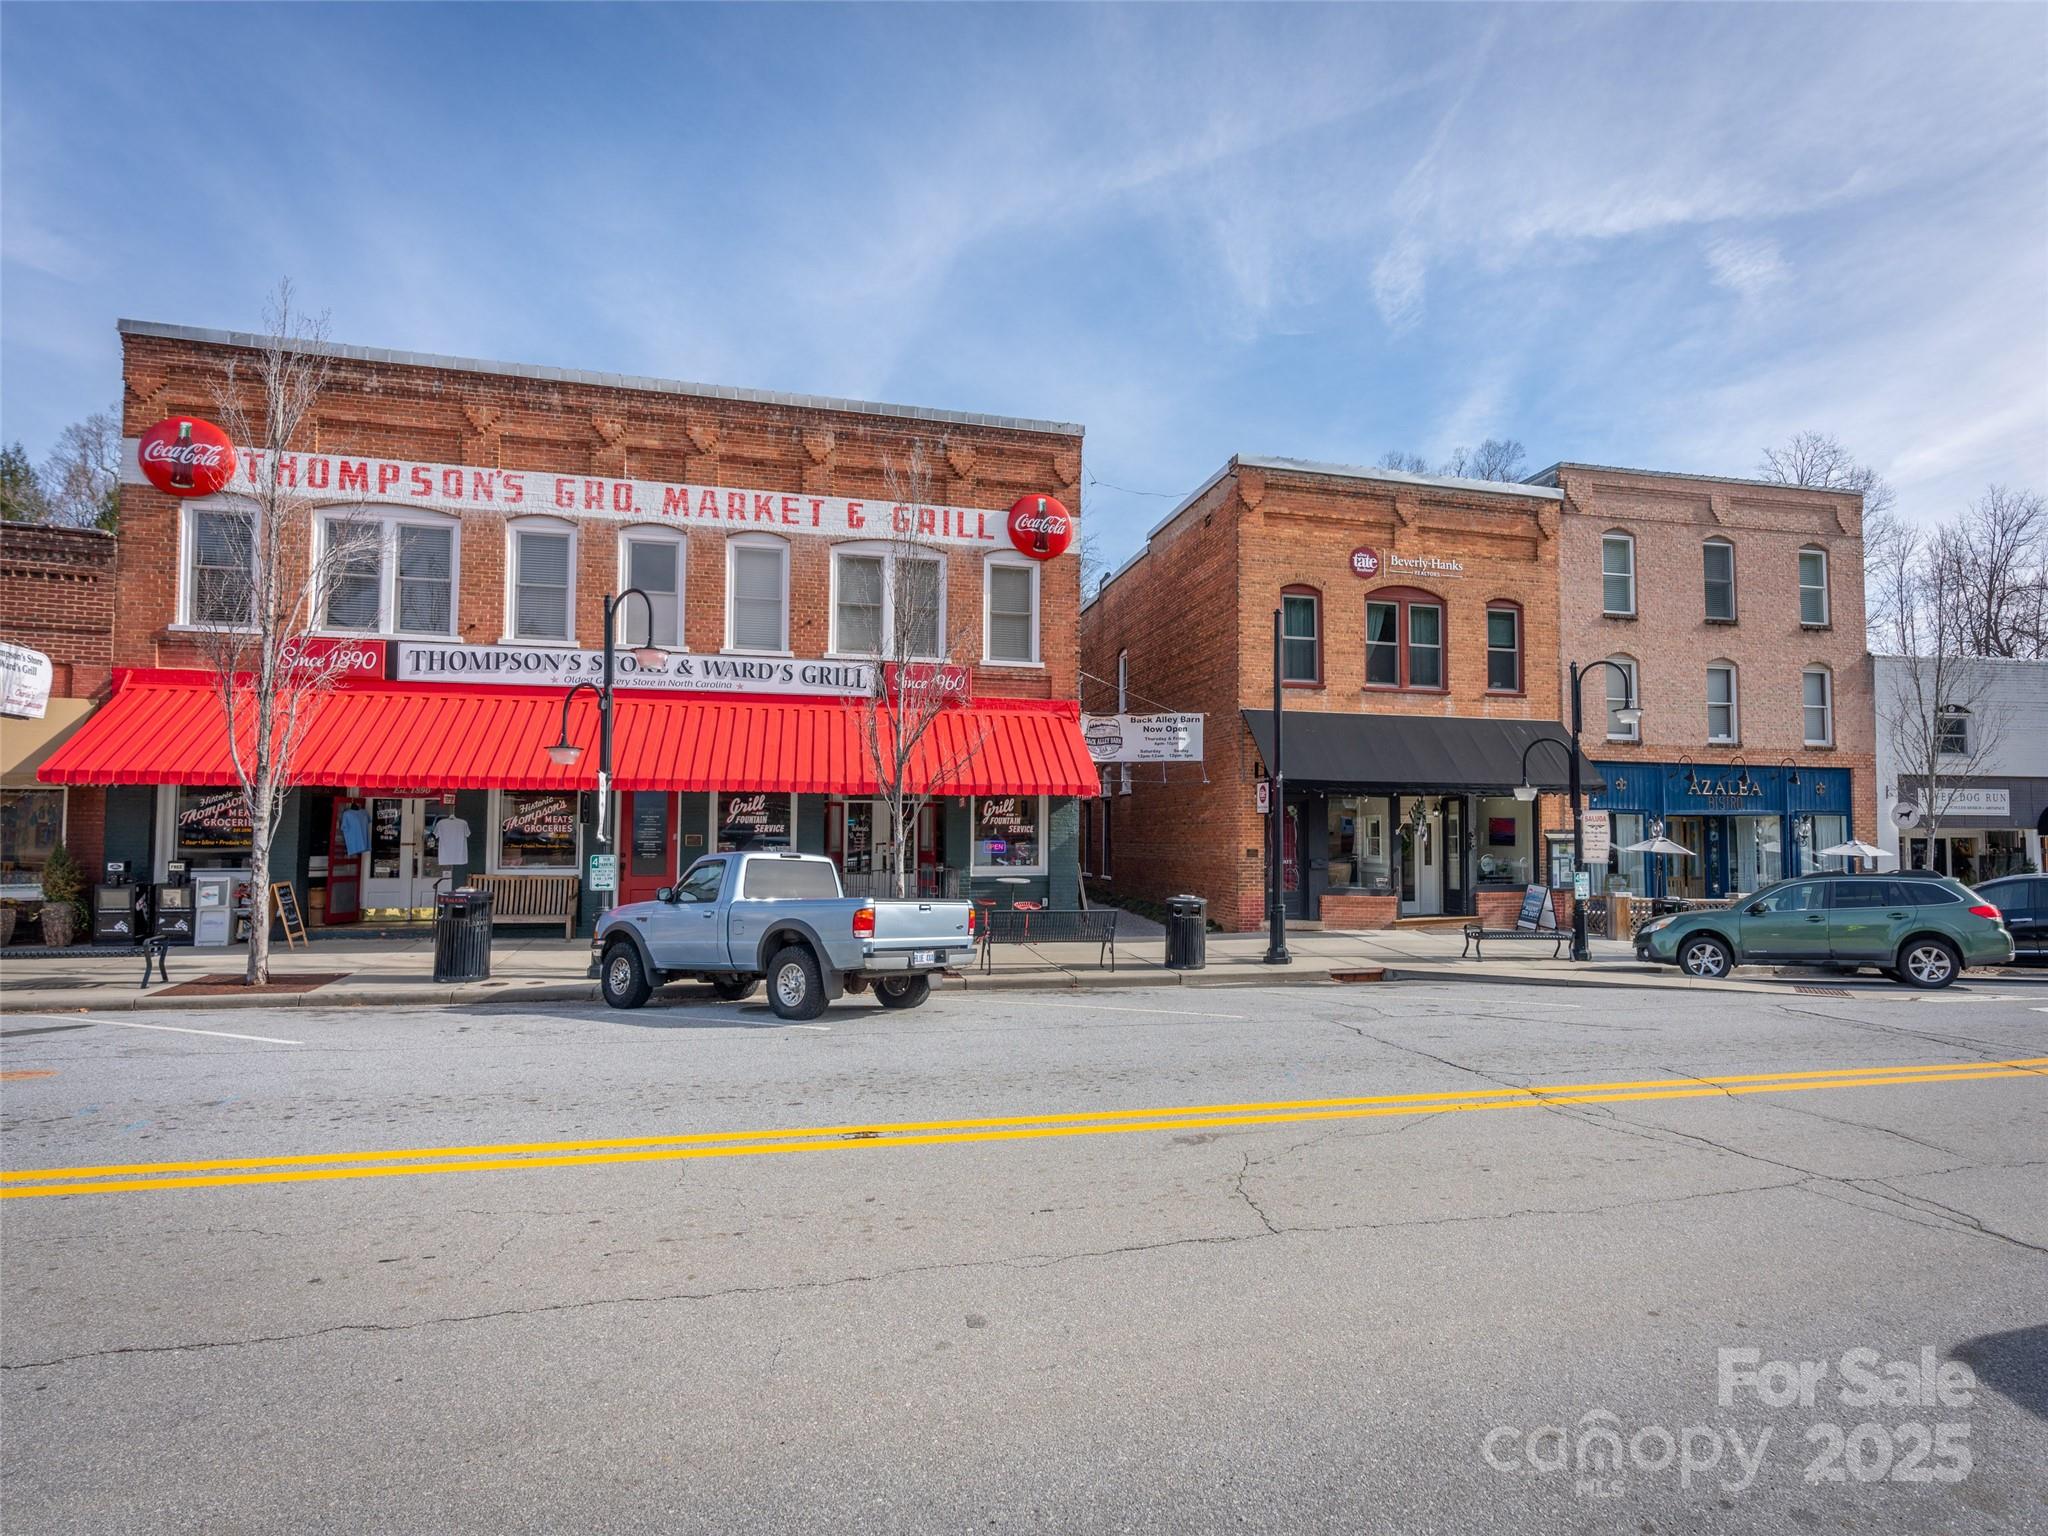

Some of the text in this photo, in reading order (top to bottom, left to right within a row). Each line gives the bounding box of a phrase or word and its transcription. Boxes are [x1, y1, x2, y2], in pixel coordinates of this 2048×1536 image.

[144, 439, 224, 467] Coca-Cola
[243, 452, 524, 504] THOMPSON'S
[661, 487, 825, 527] MARKET
[847, 503, 866, 529] &
[892, 506, 995, 540] GRILL
[1015, 513, 1067, 536] Coca-Cola
[1352, 553, 1377, 568] tate
[1391, 554, 1463, 571] Beverly-Hanks
[27, 655, 43, 666] Store
[280, 646, 377, 670] Since 1890
[22, 665, 38, 675] Grill
[409, 650, 581, 673] THOMPSON'S
[677, 659, 693, 675] &
[703, 660, 793, 682] WARD'S
[801, 664, 867, 690] GRILL
[564, 675, 732, 689] Oldest Gcery Store in North Carolina
[892, 671, 928, 691] Since
[1155, 716, 1178, 724] Alley
[1165, 725, 1188, 733] Open
[1687, 779, 1764, 796] AZALEA
[200, 791, 233, 807] Historic
[1709, 796, 1745, 810] BISTRO
[1921, 792, 2006, 802] RVER DOG RUN
[179, 795, 250, 826] Thompson
[519, 796, 554, 814] Historic
[727, 794, 766, 824] Grill
[983, 798, 1015, 825] Grill
[228, 809, 251, 818] MEA
[503, 800, 567, 832] Thompson's
[544, 815, 573, 823] MEATS
[735, 815, 768, 824] FOUNTAIN
[203, 818, 254, 827] GROCERIE
[990, 817, 1021, 825] FOUNTAIN
[524, 824, 573, 833] GROCERIES
[754, 824, 785, 833] SERVICE
[1008, 825, 1034, 833] SERVICE
[592, 858, 598, 867] 4
